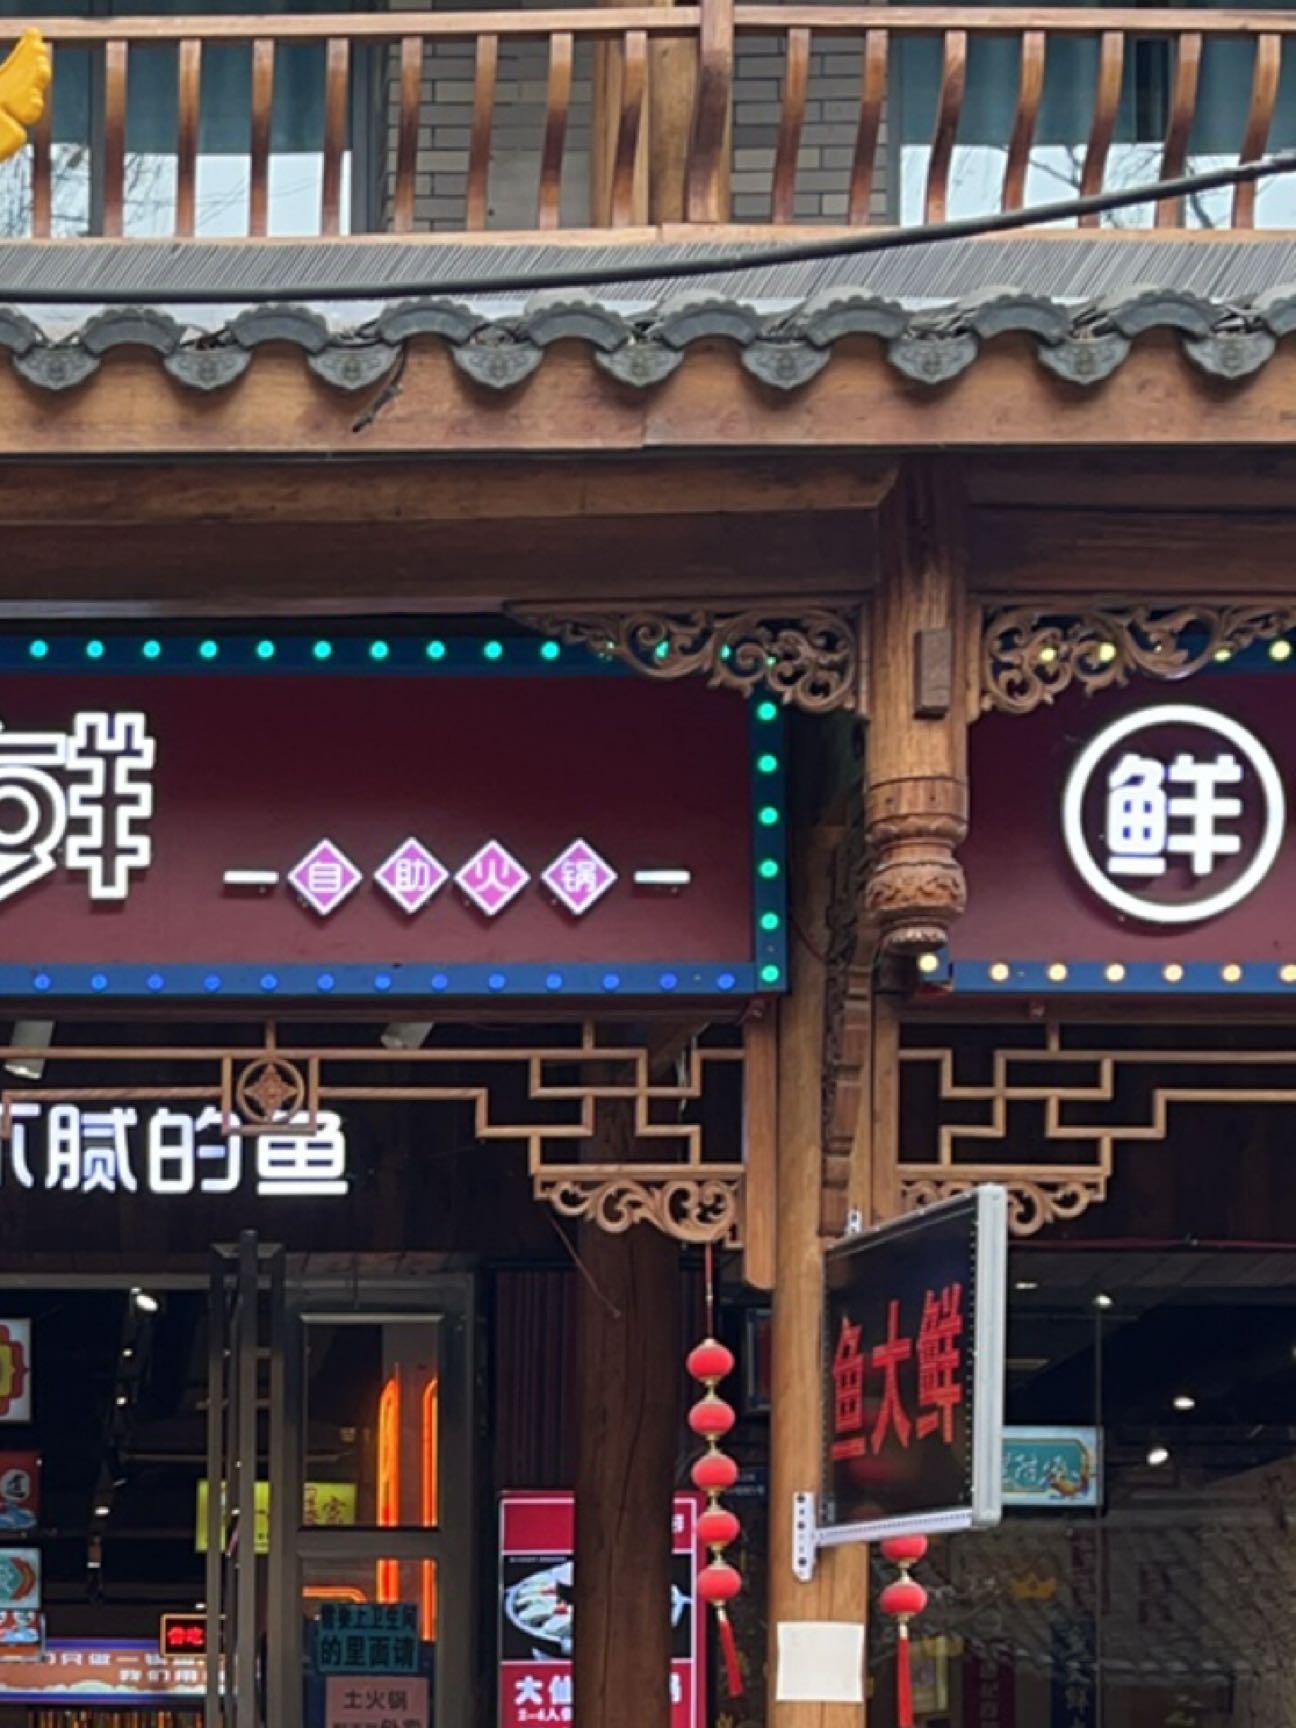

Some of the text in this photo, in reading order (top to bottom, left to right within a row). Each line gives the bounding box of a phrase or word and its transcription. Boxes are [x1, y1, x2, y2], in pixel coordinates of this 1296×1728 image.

[1105, 755, 1243, 879] 鲜
[298, 846, 612, 908] 自助火锅
[829, 1282, 965, 1461] 鱼大鲜
[343, 1687, 409, 1712] 土火锅
